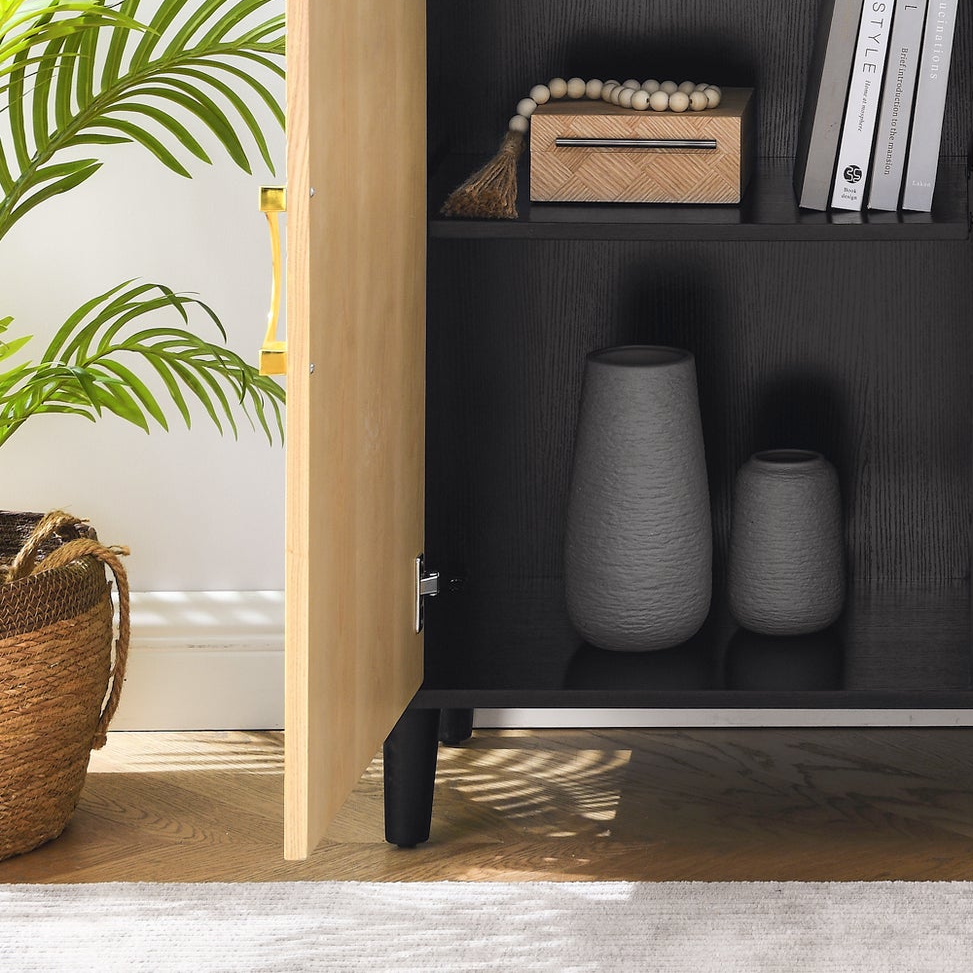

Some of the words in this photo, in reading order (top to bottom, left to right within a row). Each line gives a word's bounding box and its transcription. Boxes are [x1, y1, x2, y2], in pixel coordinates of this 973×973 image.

[899, 47, 909, 68] Brief
[863, 80, 871, 98] Home
[892, 68, 907, 116] introduction
[891, 118, 898, 127] to
[889, 128, 897, 141] the
[884, 142, 894, 175] mansion
